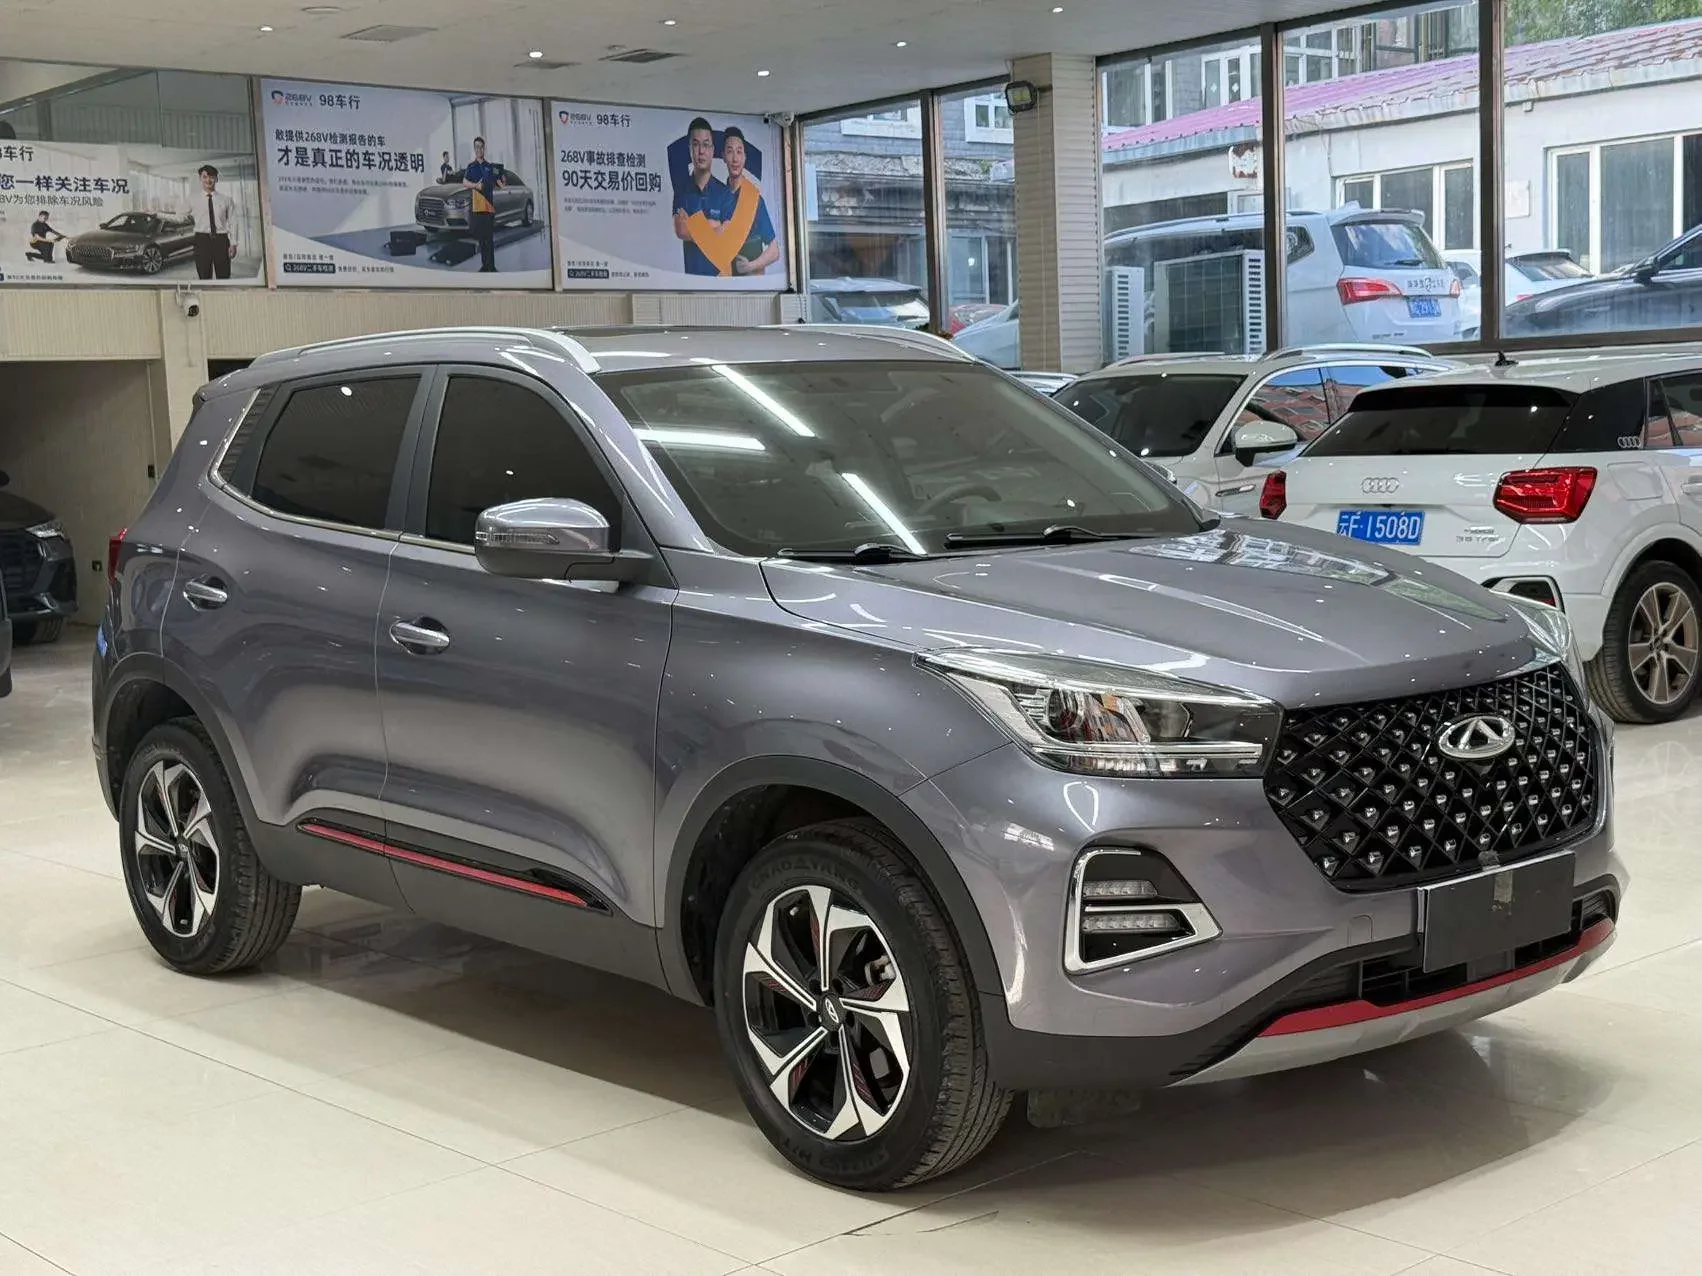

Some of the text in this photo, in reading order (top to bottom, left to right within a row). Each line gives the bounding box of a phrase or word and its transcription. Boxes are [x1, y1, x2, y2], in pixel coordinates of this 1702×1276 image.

[319, 94, 361, 109] 98车行
[597, 114, 631, 128] 98车行
[277, 145, 425, 173] 才是真正的车况透明
[560, 150, 646, 168] 268V事故排查检测
[562, 169, 662, 193] 90天交易价回购
